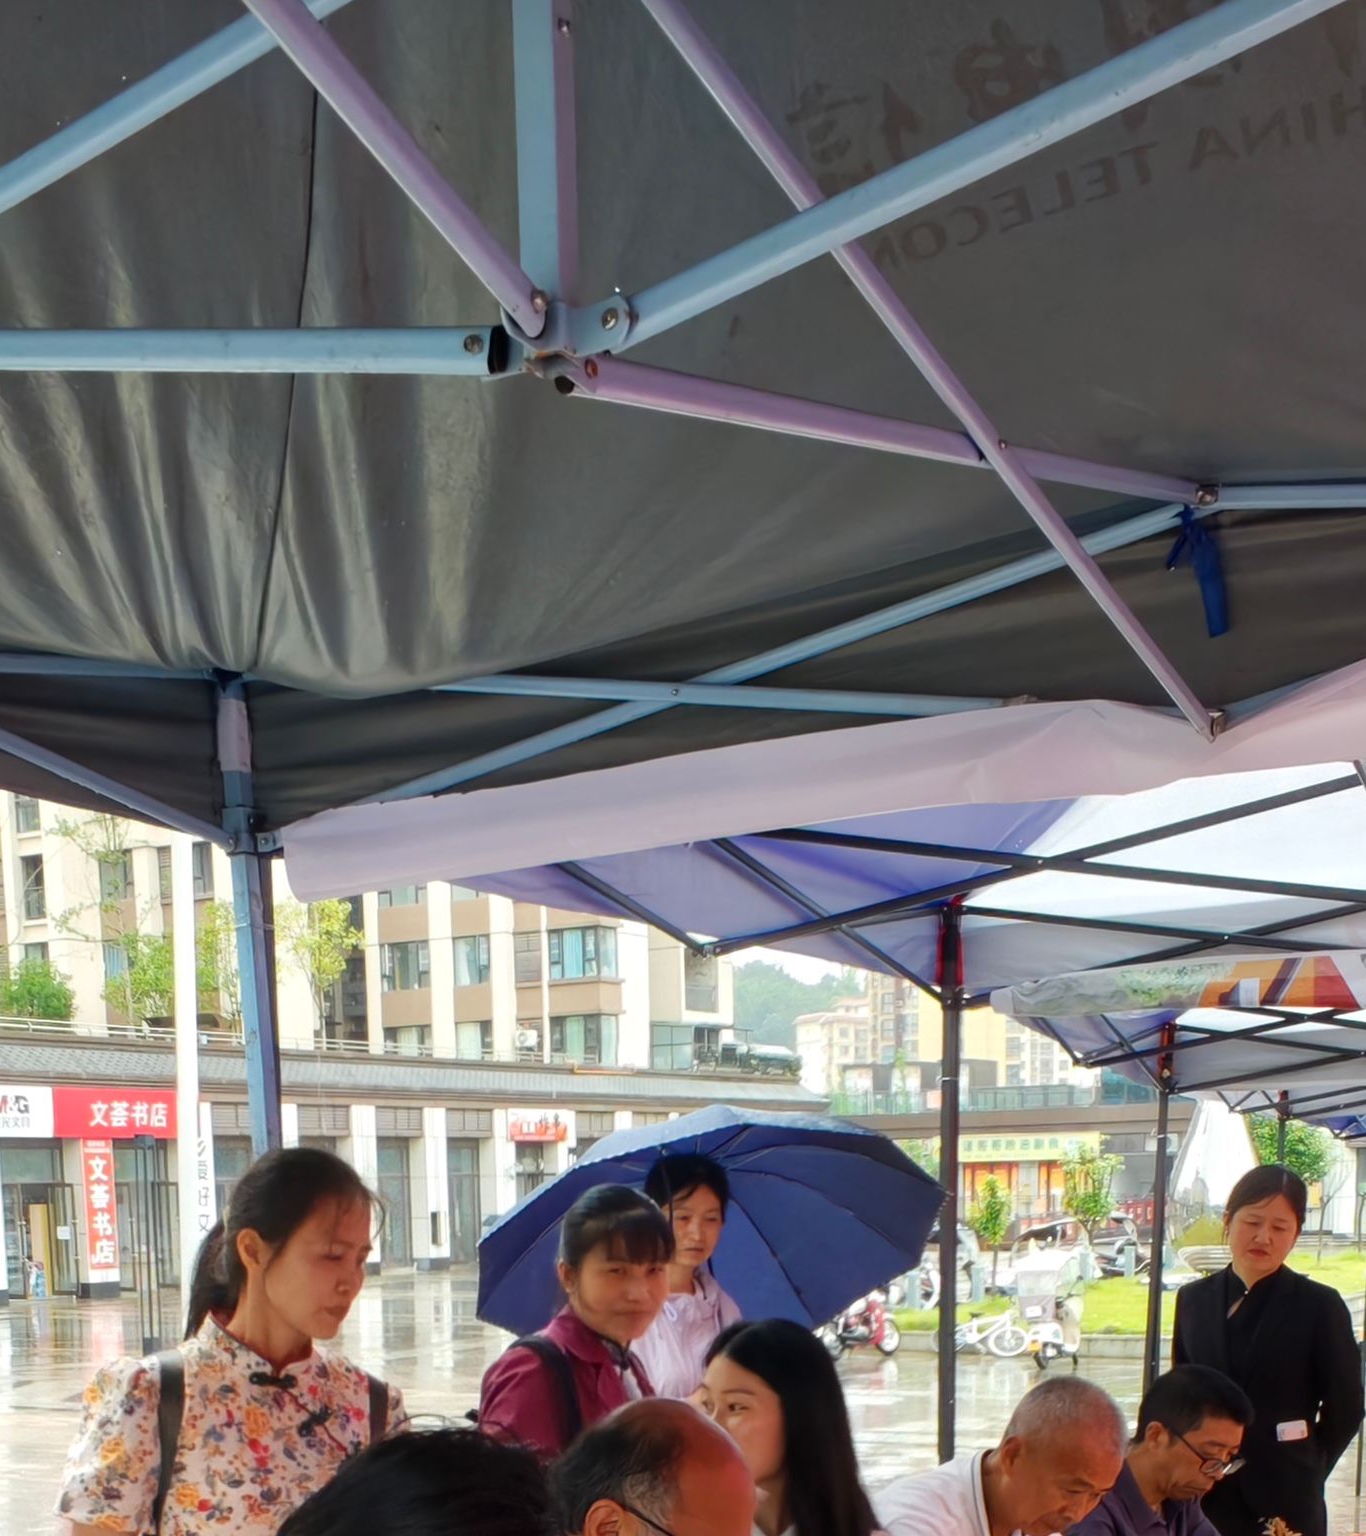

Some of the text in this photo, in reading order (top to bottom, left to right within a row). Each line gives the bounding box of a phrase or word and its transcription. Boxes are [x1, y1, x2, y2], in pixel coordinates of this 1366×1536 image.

[89, 1100, 168, 1128] 文荟书店
[88, 1155, 115, 1264] 文荟书店
